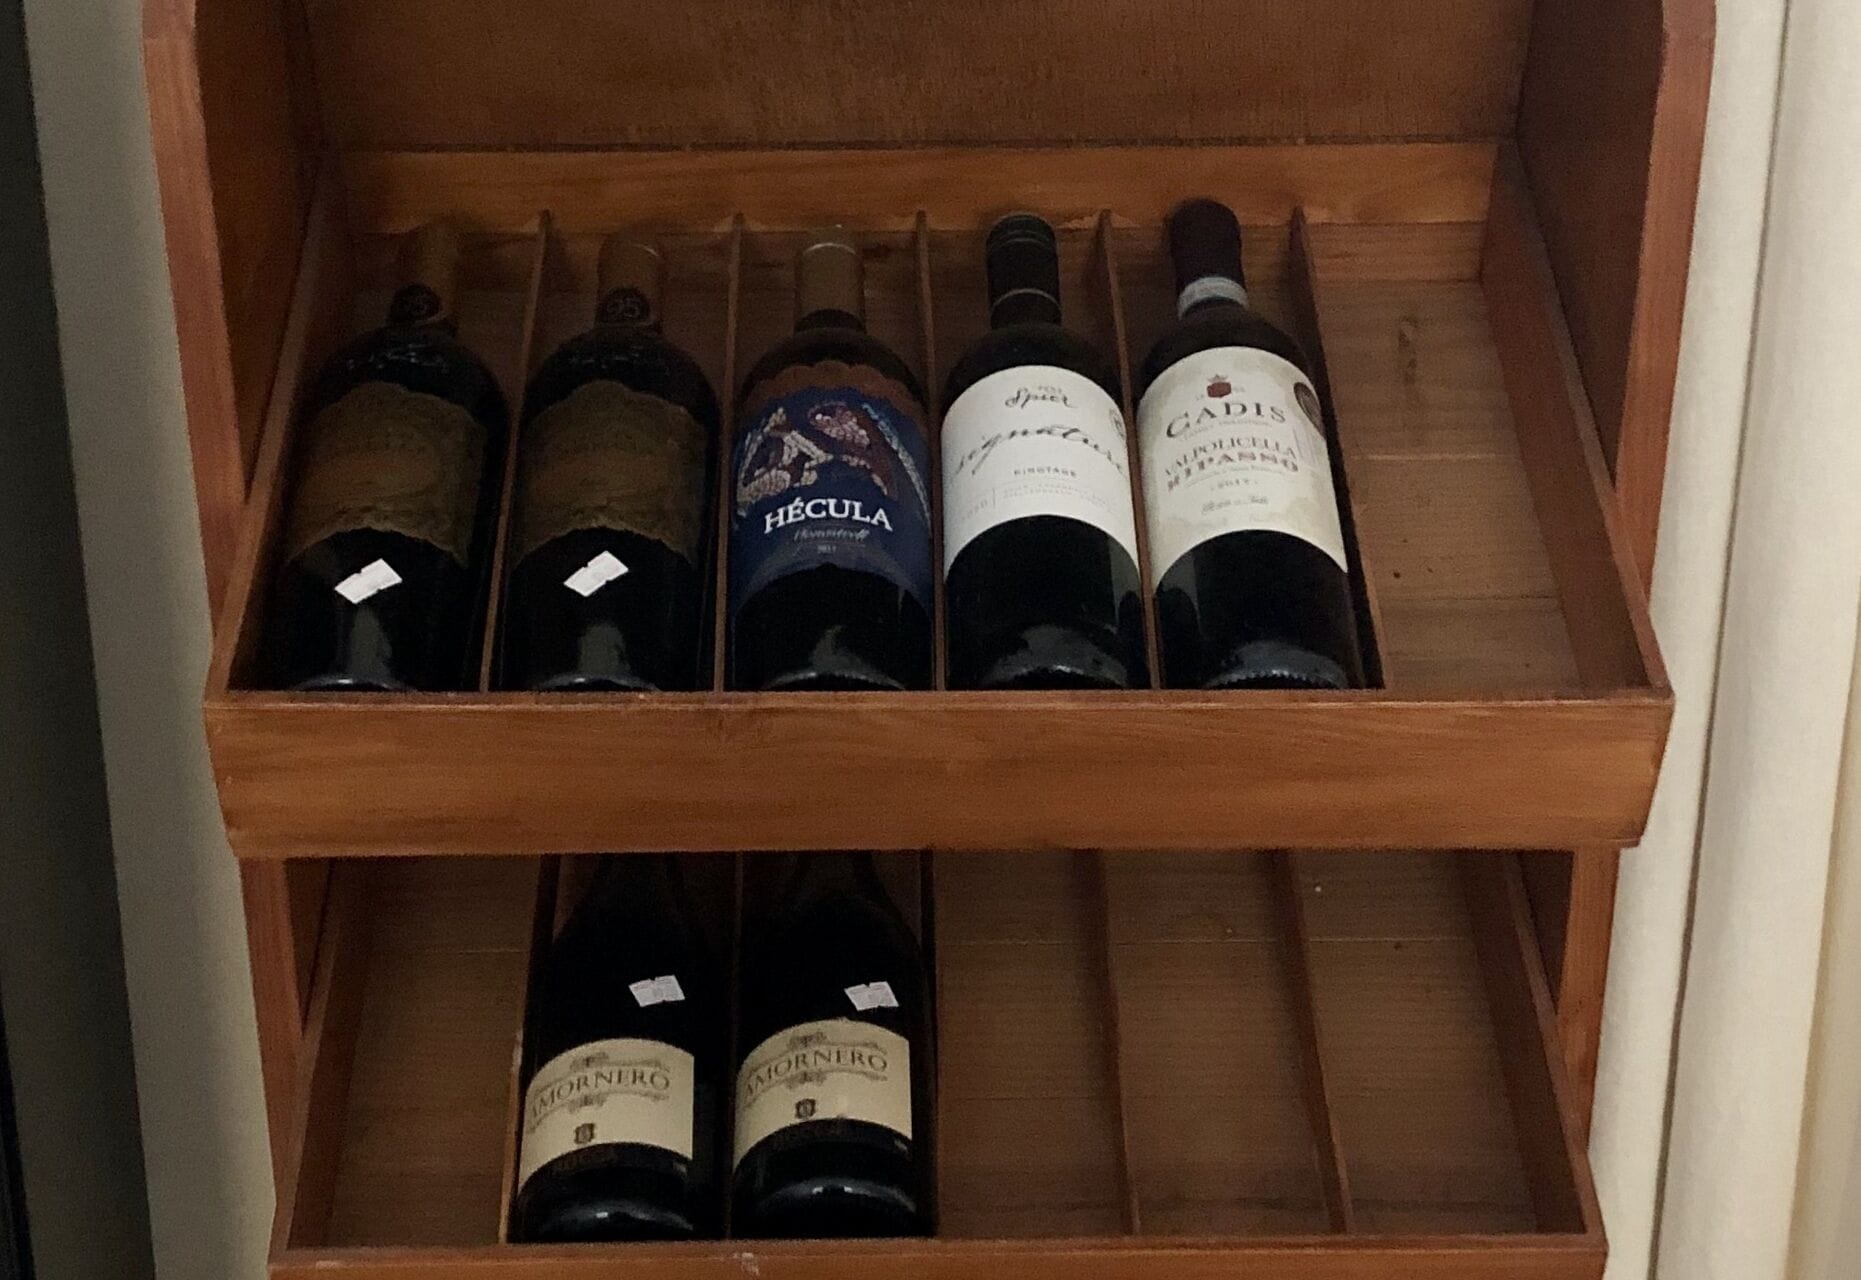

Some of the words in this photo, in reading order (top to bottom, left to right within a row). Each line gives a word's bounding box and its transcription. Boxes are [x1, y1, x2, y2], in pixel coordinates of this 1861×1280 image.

[1165, 401, 1287, 439] CADIS
[1164, 436, 1298, 476] VALPOLICELLA
[1167, 451, 1300, 494] RIPASSO
[763, 496, 893, 535] HÉCULA
[745, 1046, 889, 1100] AMORNERO
